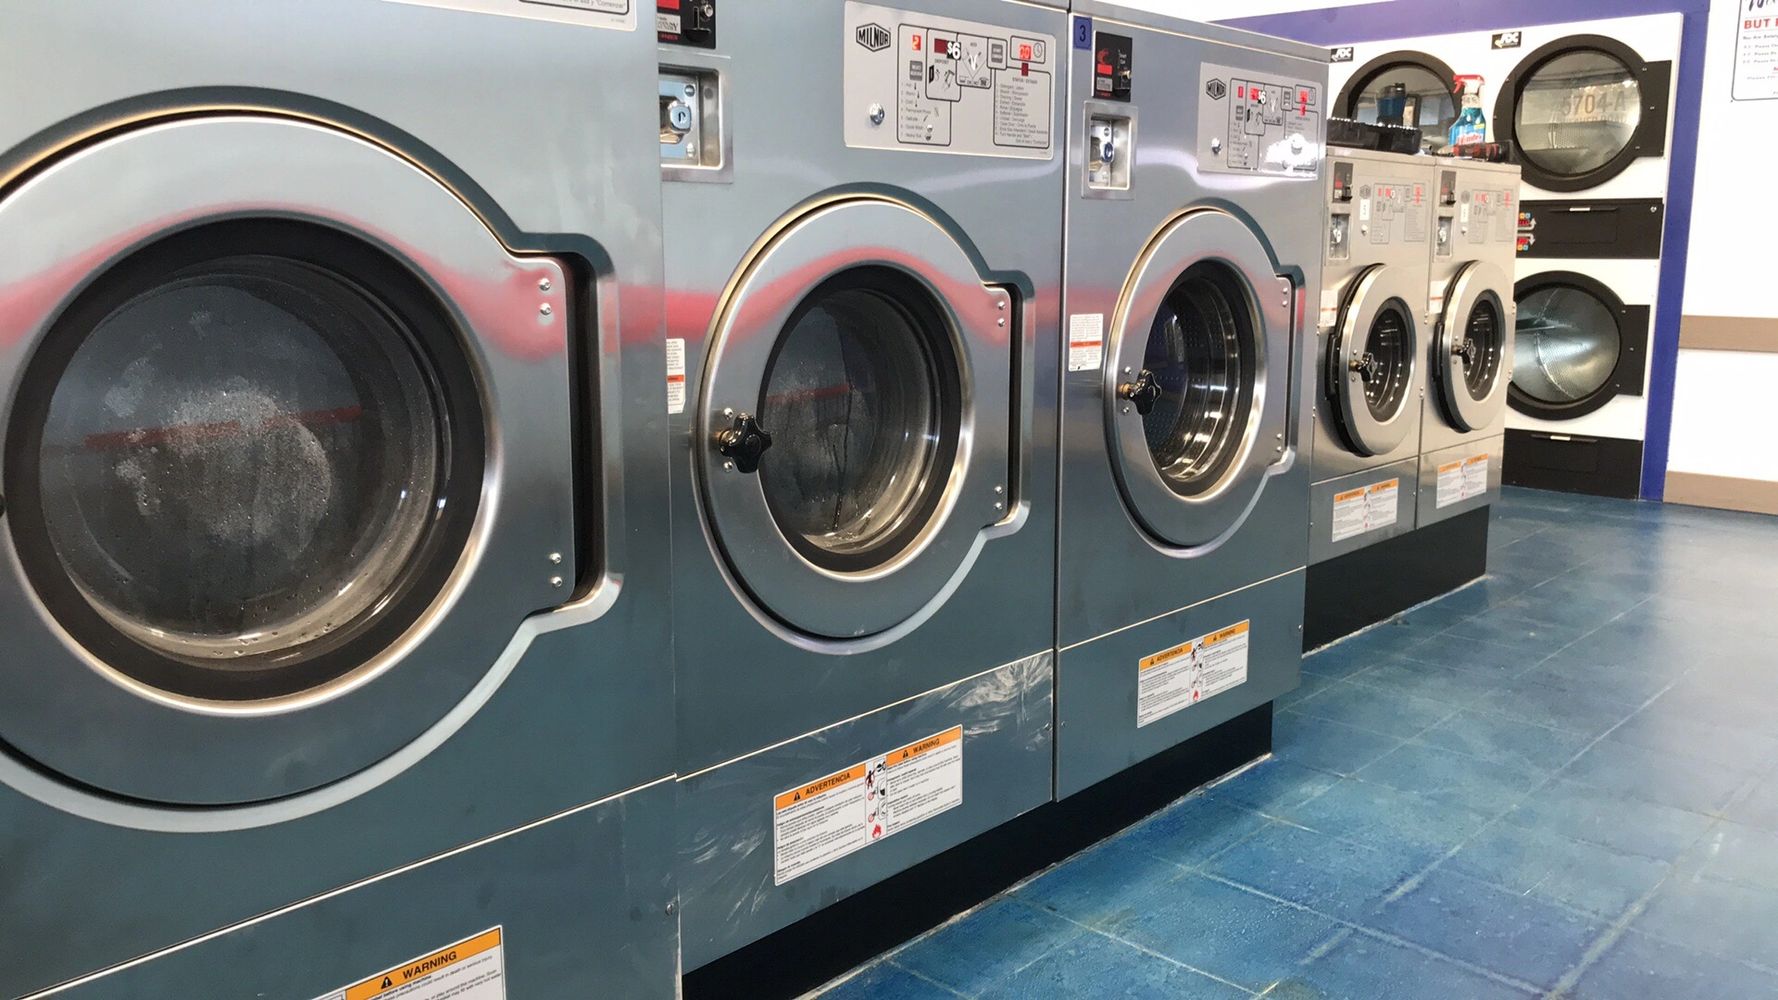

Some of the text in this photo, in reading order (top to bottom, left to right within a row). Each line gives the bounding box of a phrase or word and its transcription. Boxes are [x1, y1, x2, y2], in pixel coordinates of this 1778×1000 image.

[1744, 18, 1771, 29] BUT
[858, 26, 889, 48] MILNOR
[1080, 25, 1086, 42] 3
[913, 36, 920, 50] 2
[947, 41, 961, 59] $6
[913, 738, 940, 753] WARNING
[805, 772, 851, 795] ADVERTENCIA
[403, 951, 457, 980] WARNING
